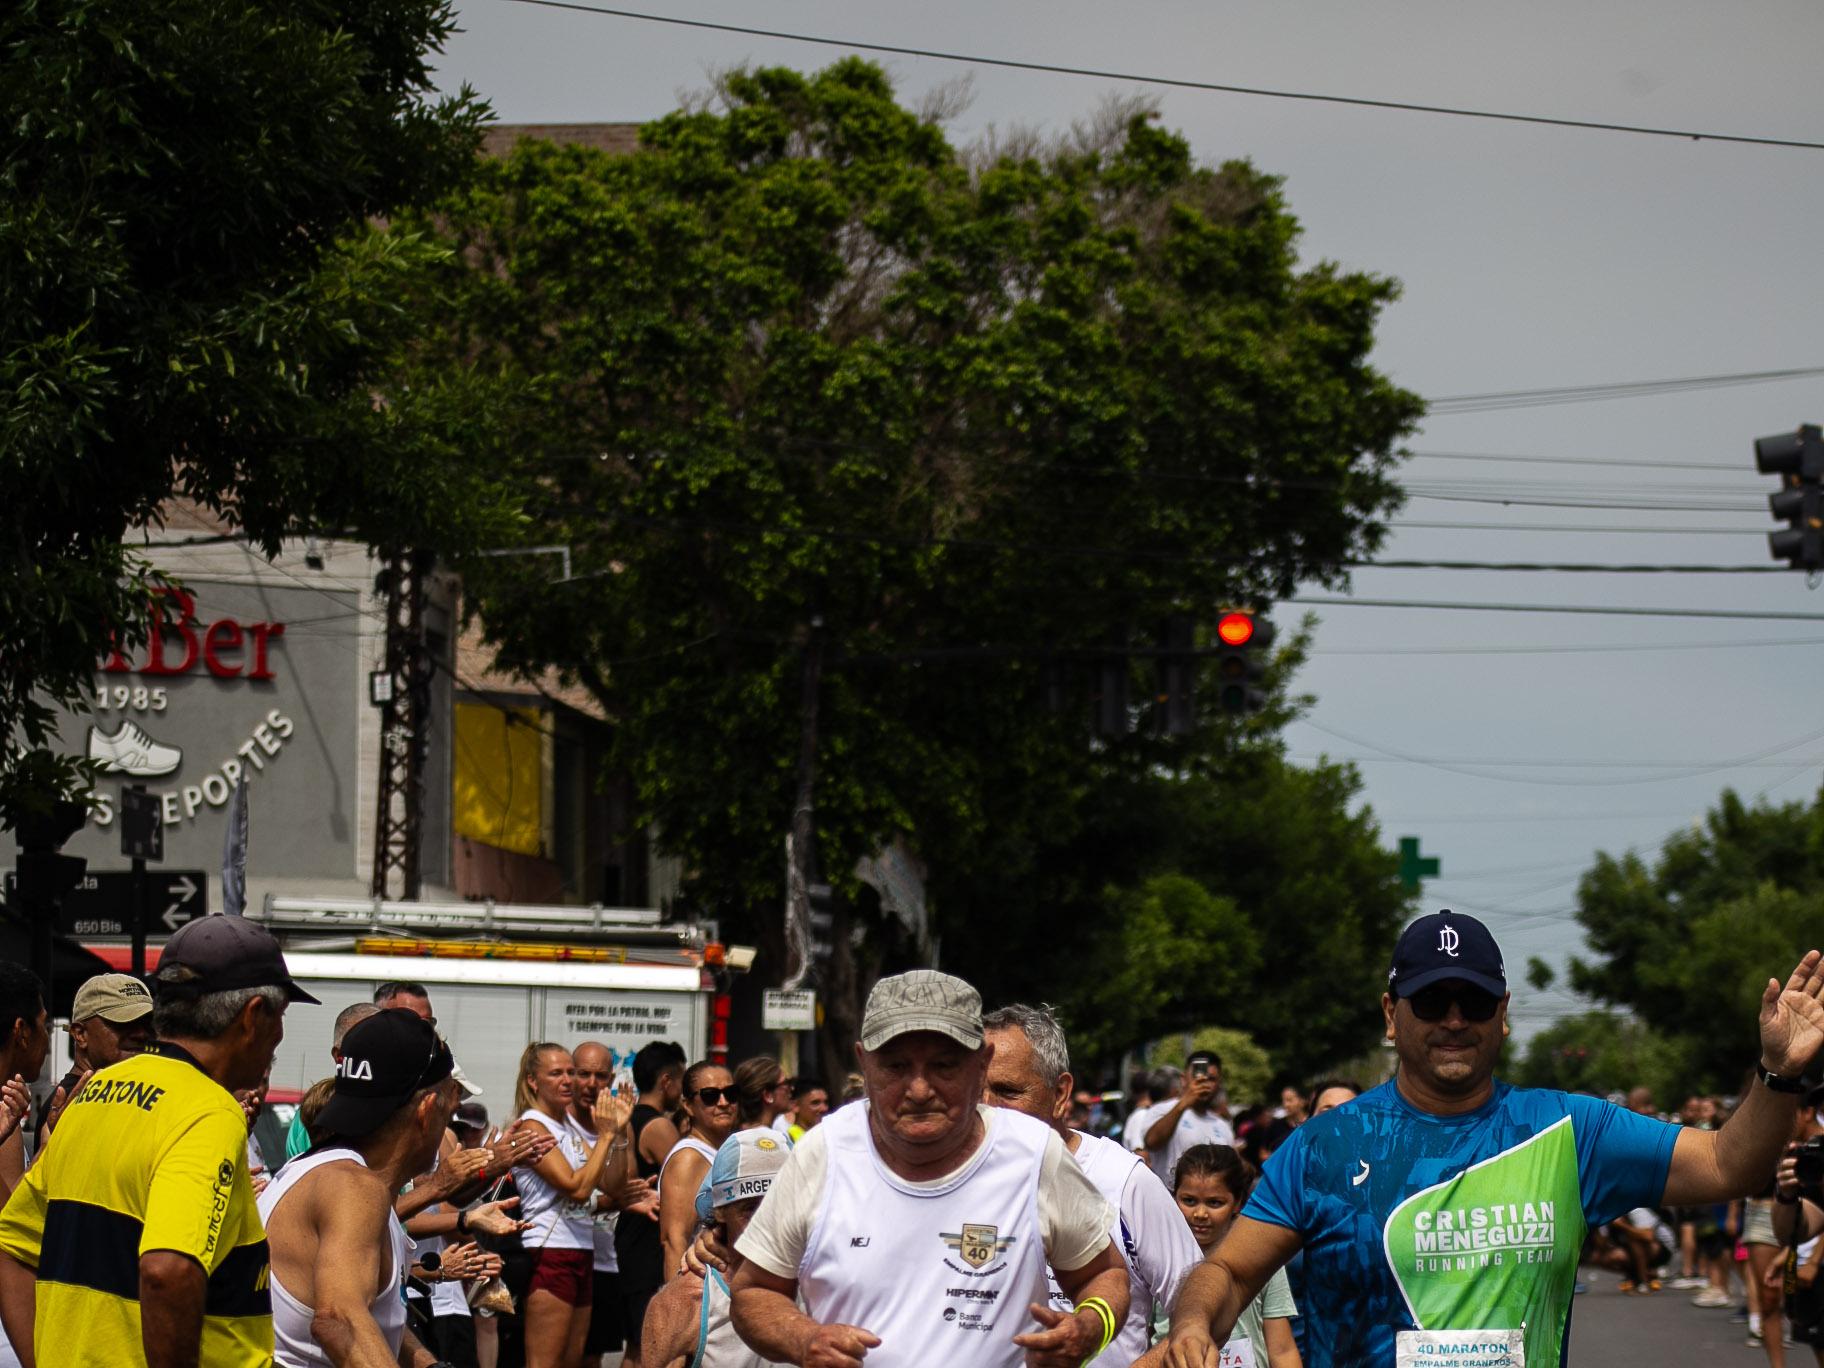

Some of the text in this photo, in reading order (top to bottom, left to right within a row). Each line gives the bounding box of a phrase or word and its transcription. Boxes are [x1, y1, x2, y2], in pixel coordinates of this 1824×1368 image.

[97, 685, 168, 711] 1985
[162, 708, 295, 825] EPORTES
[75, 1079, 167, 1112] EGATONE
[206, 1182, 229, 1253] unicef
[1414, 1200, 1555, 1231] CRISTIAN
[1414, 1222, 1555, 1252] MENEGUZZI
[968, 1247, 989, 1261] 40
[1415, 1249, 1554, 1272] RUNNING TEAM
[1414, 1357, 1511, 1368] EMPALME GRANEROS
[1418, 1343, 1509, 1355] 40 MARATON
